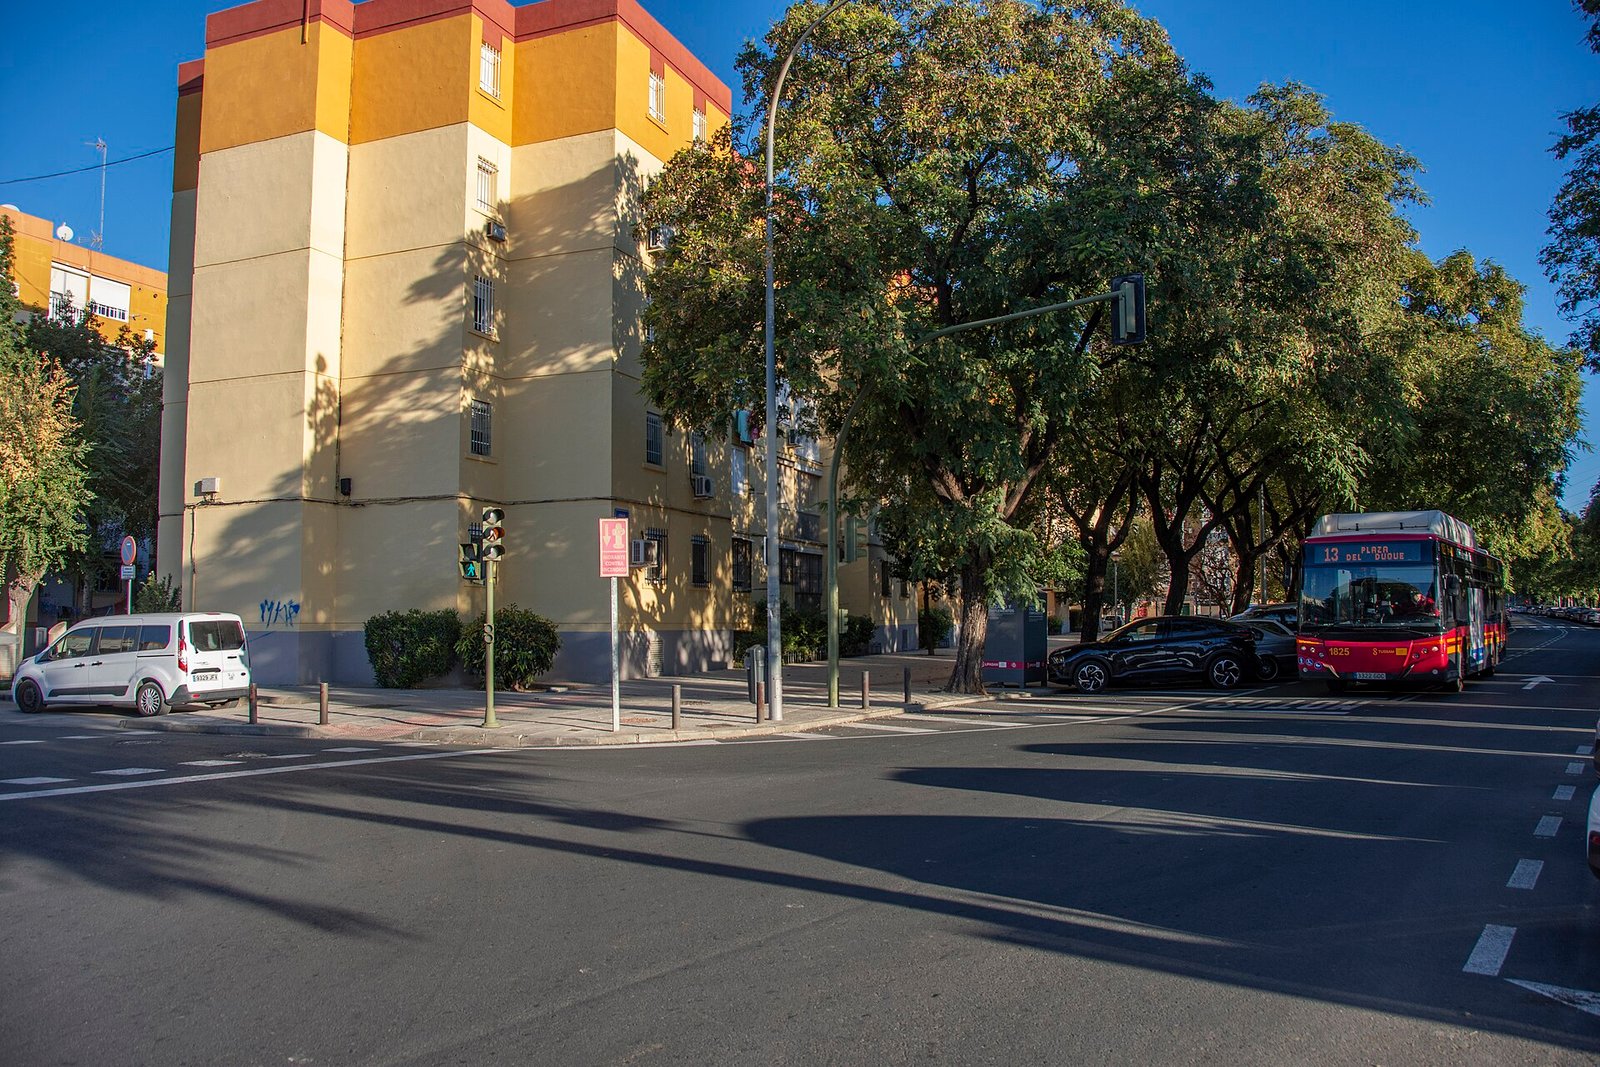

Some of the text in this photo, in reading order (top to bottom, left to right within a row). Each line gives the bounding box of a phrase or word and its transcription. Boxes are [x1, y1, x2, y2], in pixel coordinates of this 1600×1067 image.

[1361, 545, 1388, 554] PLAZA
[1324, 547, 1339, 562] 13
[1346, 553, 1362, 561] DEL
[1328, 647, 1350, 656] 1825
